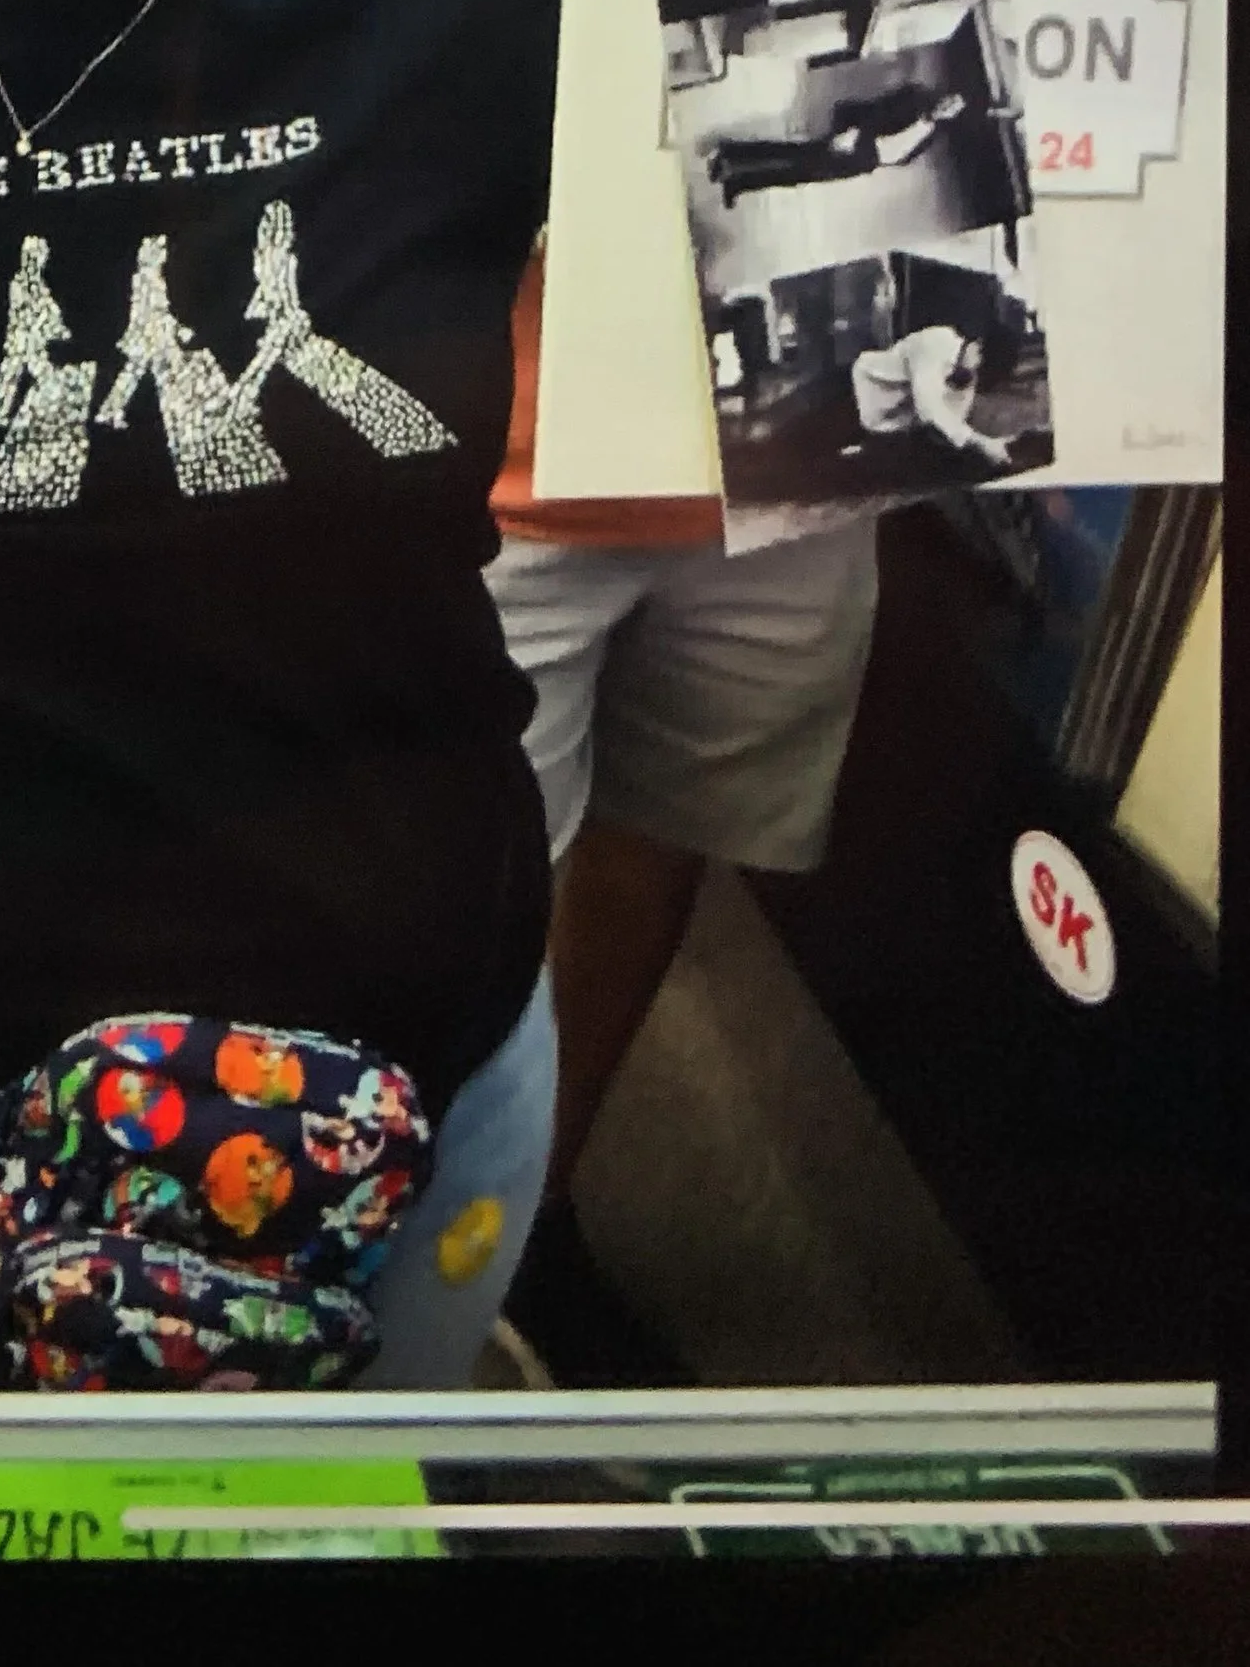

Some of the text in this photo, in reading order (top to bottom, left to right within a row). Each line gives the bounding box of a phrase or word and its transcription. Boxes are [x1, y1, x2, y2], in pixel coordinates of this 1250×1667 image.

[1025, 14, 1137, 82] ON
[34, 116, 321, 192] BEATLES
[1039, 130, 1095, 171] 24
